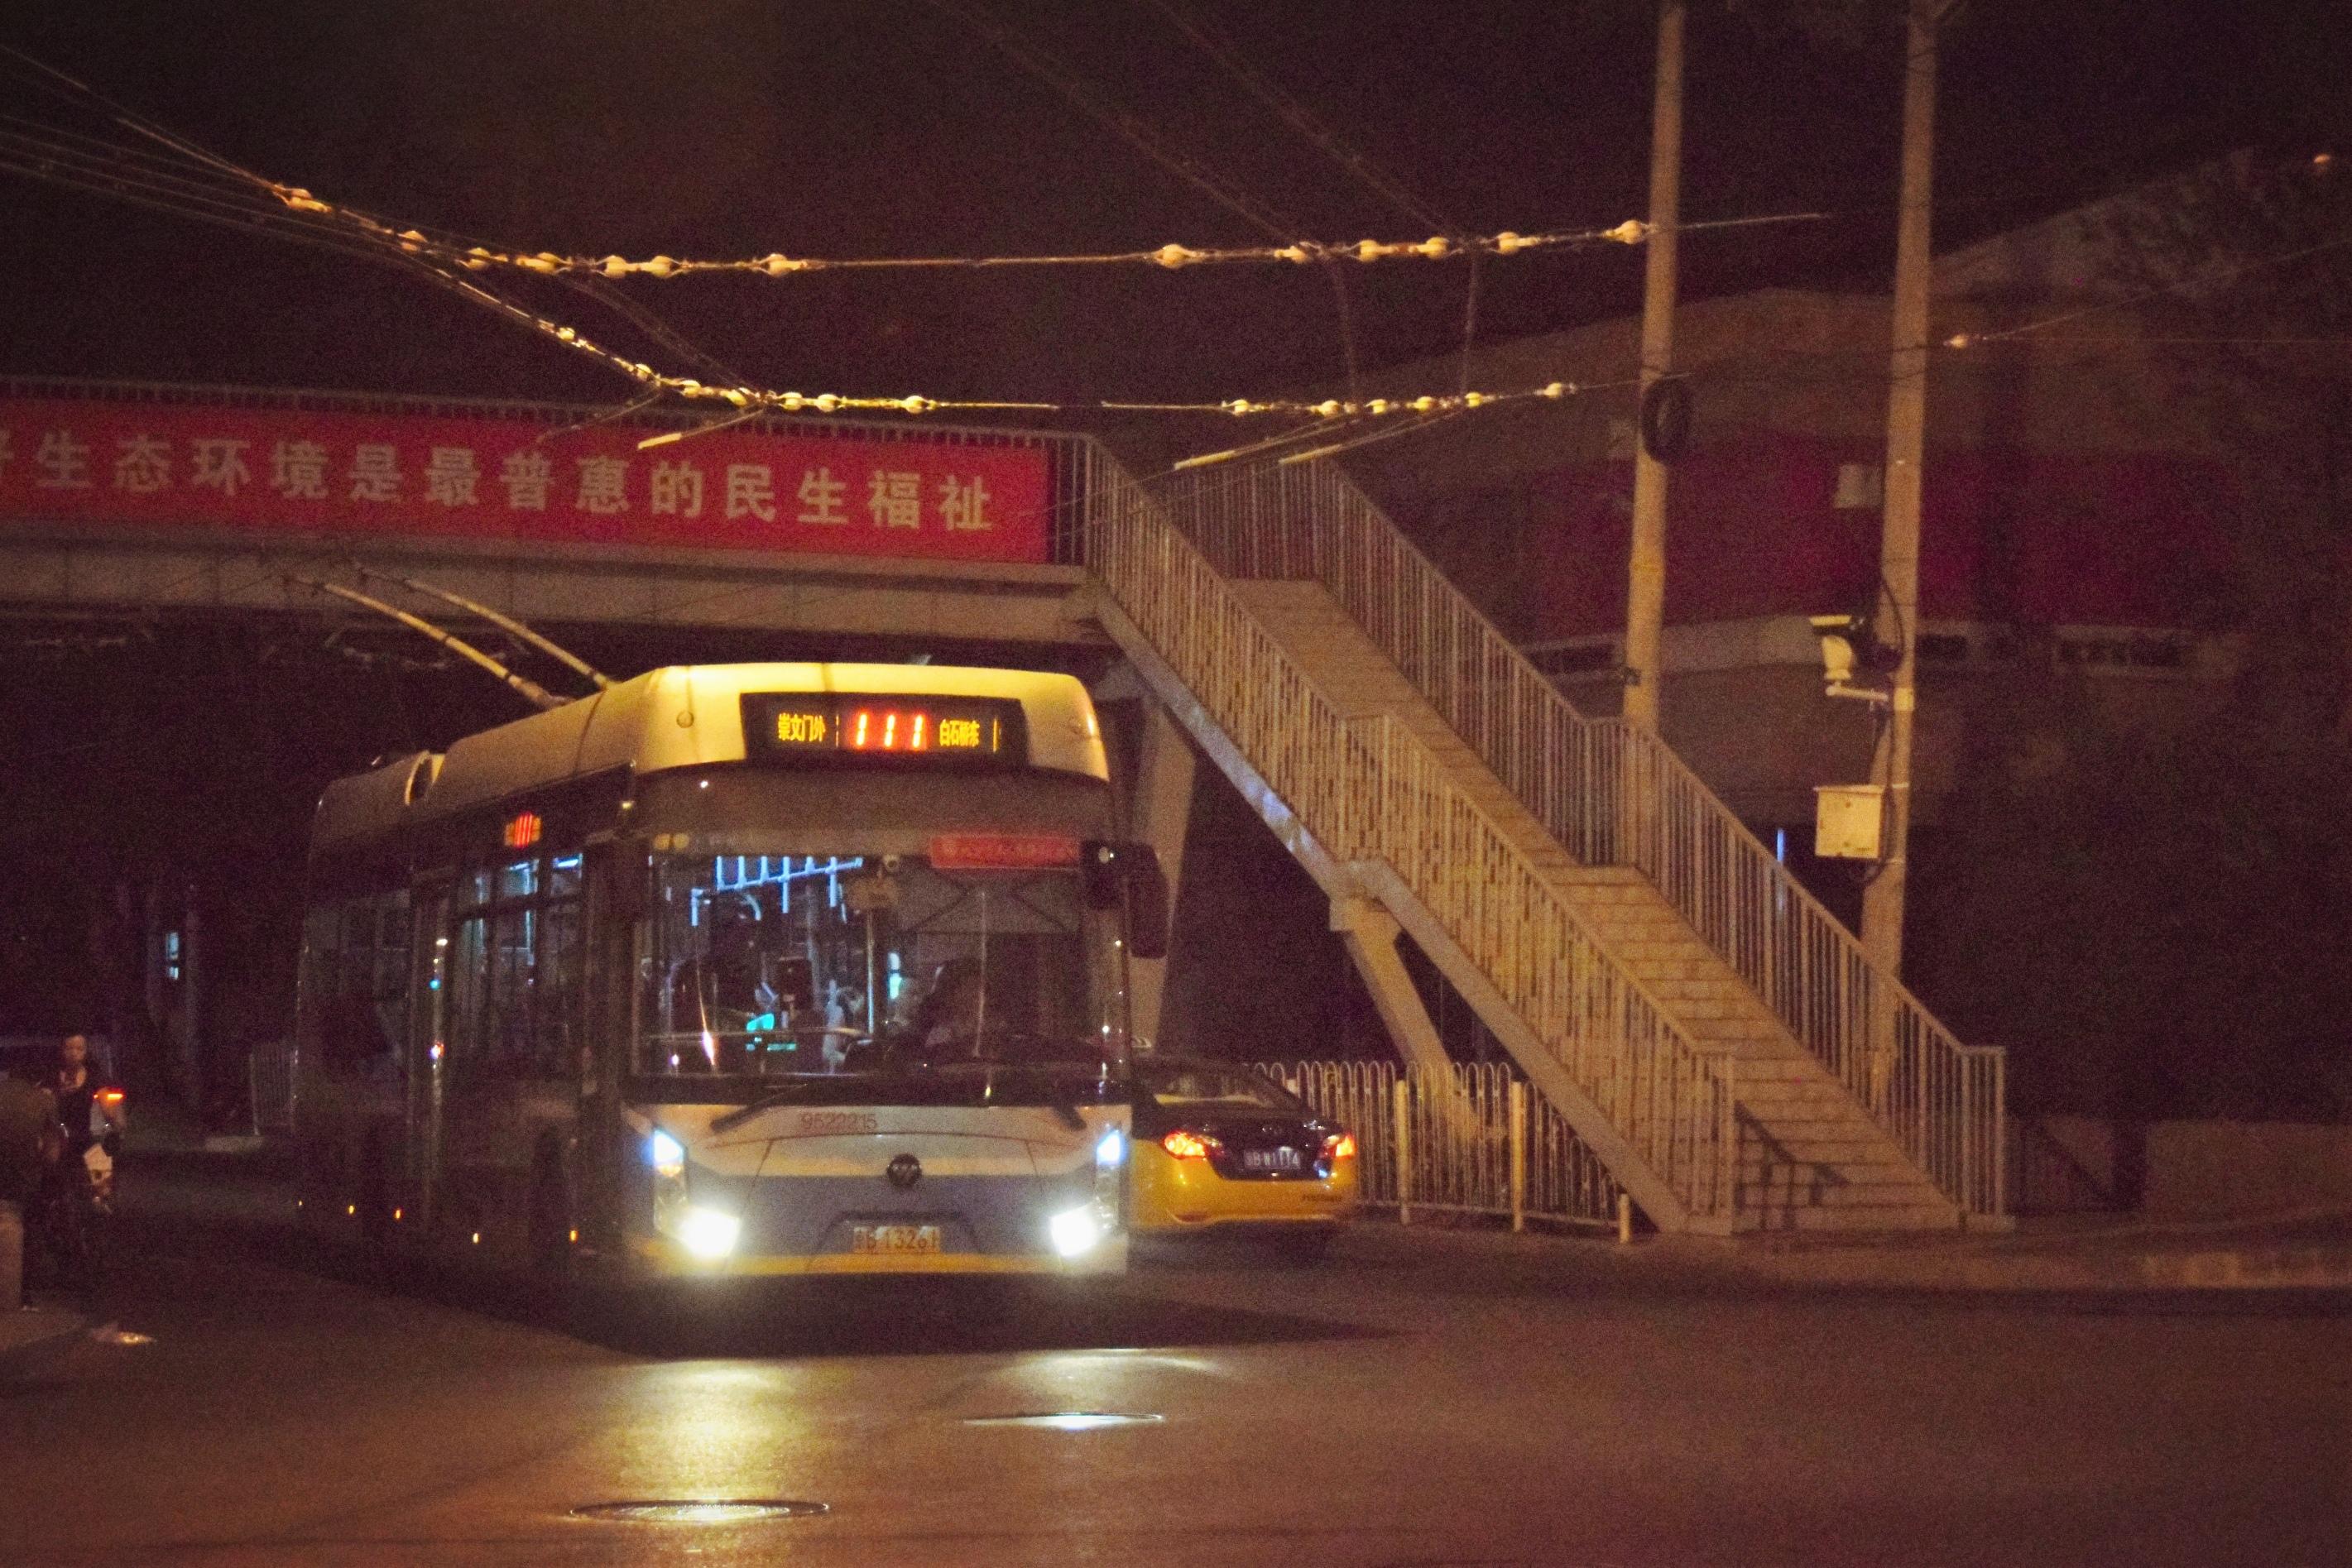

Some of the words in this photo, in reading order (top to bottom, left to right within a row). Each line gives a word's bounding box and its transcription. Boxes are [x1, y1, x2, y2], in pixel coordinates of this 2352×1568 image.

[0, 429, 994, 532] 生态环境是最普惠的民生福祉
[856, 713, 924, 747] 111
